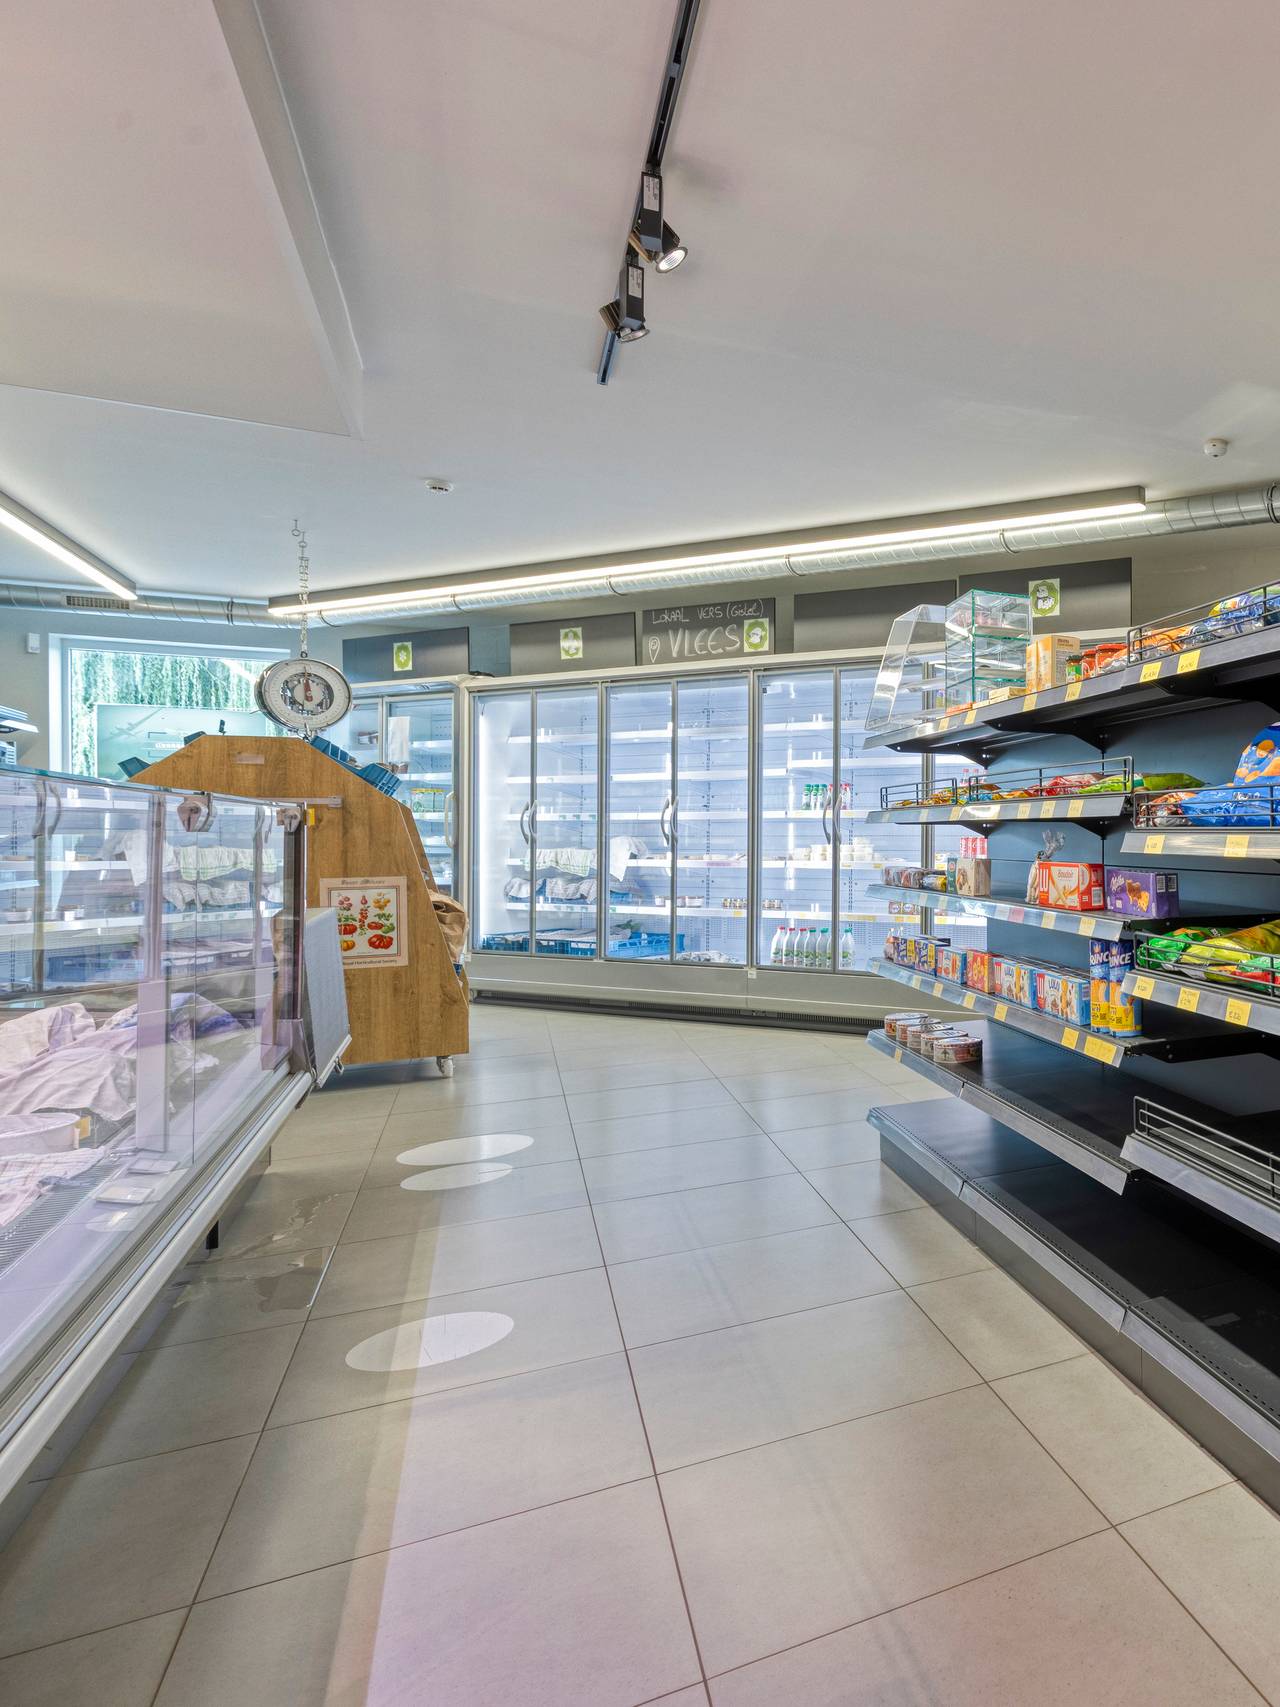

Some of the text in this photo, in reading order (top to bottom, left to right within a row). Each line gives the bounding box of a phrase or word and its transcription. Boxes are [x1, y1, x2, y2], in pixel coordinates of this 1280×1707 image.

[697, 606, 724, 620] VERS
[668, 623, 741, 658] VLEES
[1039, 868, 1049, 892] LU
